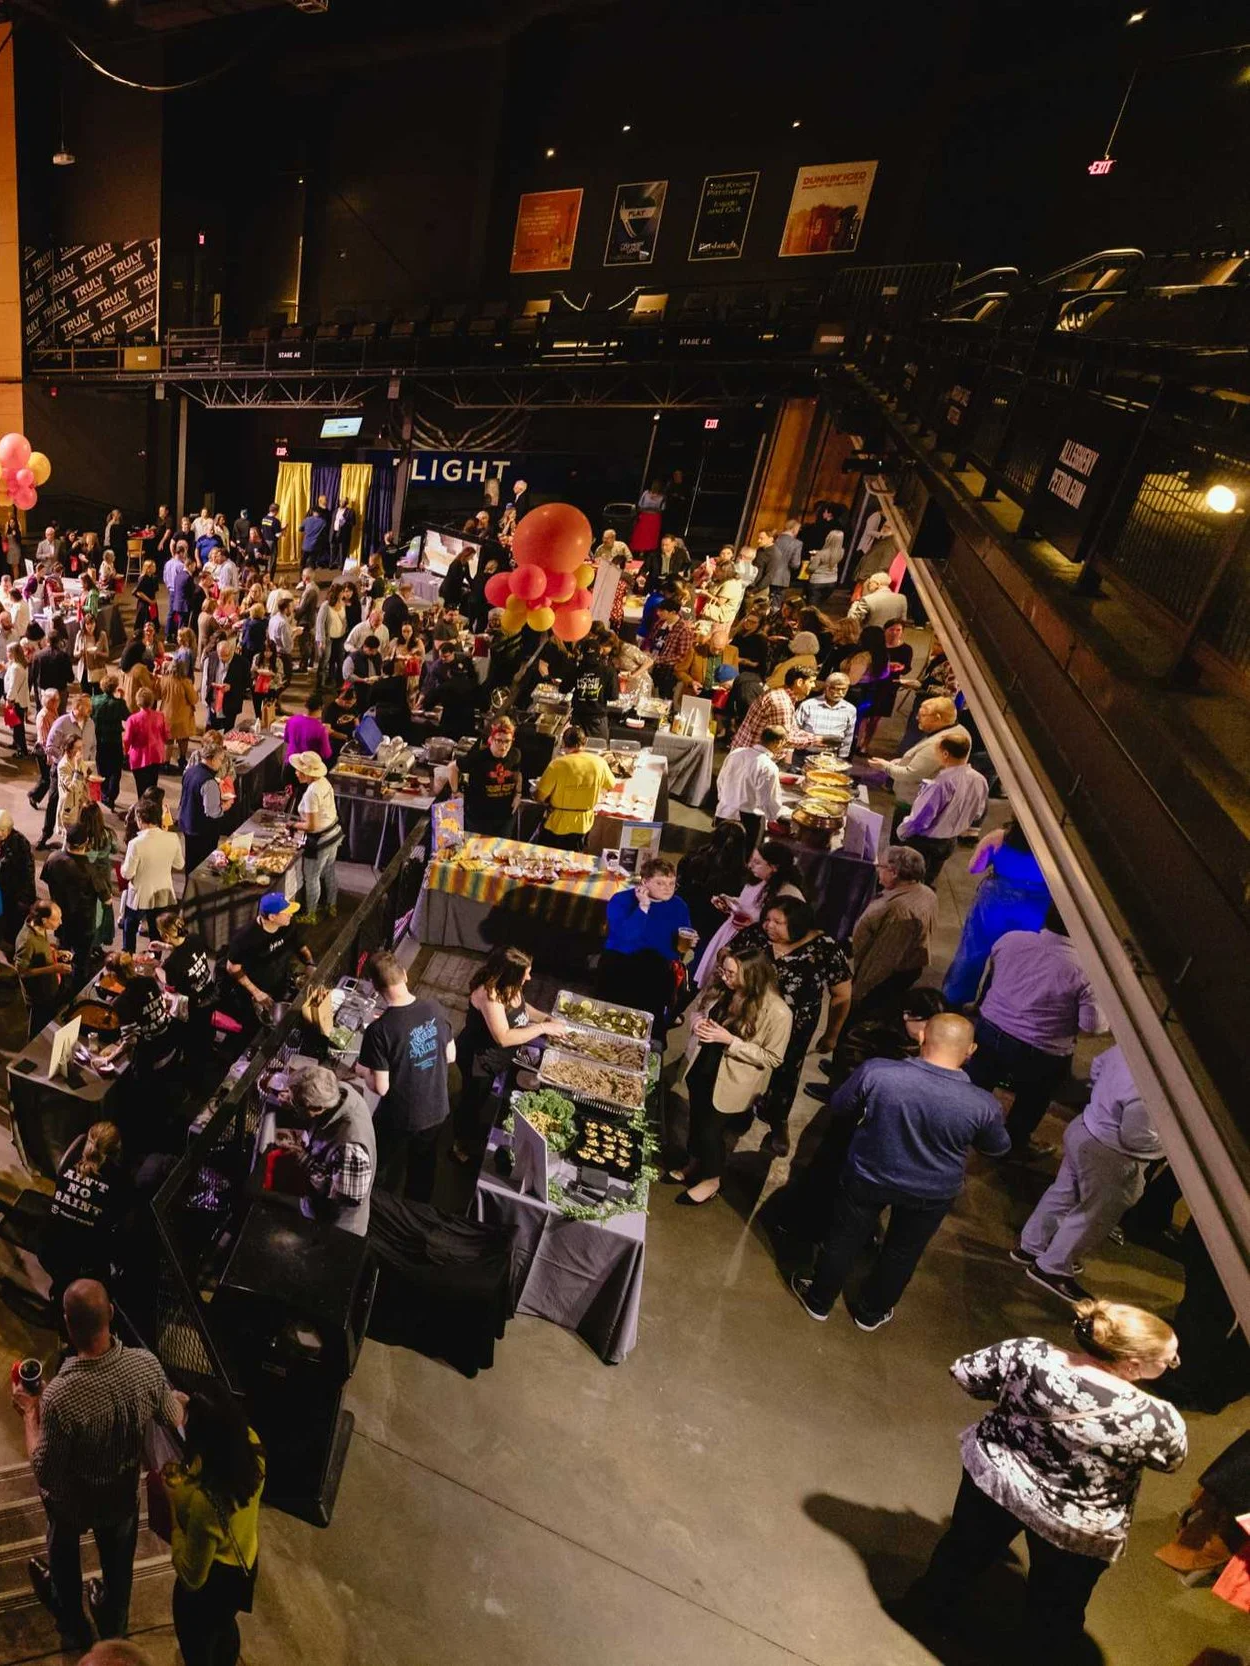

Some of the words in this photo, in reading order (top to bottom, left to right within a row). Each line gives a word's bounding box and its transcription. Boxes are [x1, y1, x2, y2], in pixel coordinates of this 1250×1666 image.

[1090, 160, 1113, 174] EXIT
[80, 242, 112, 266] TRULY
[109, 249, 142, 276] TRULY
[72, 274, 103, 299] TRULY
[134, 268, 158, 290] TRU
[96, 287, 128, 313] TRULY
[122, 299, 155, 325] TRULY
[60, 309, 91, 334] TRULY
[393, 458, 511, 482] LIGHT
[63, 1168, 109, 1193] AIN'T
[67, 1182, 91, 1198] NO
[55, 1190, 103, 1216] SAINT
